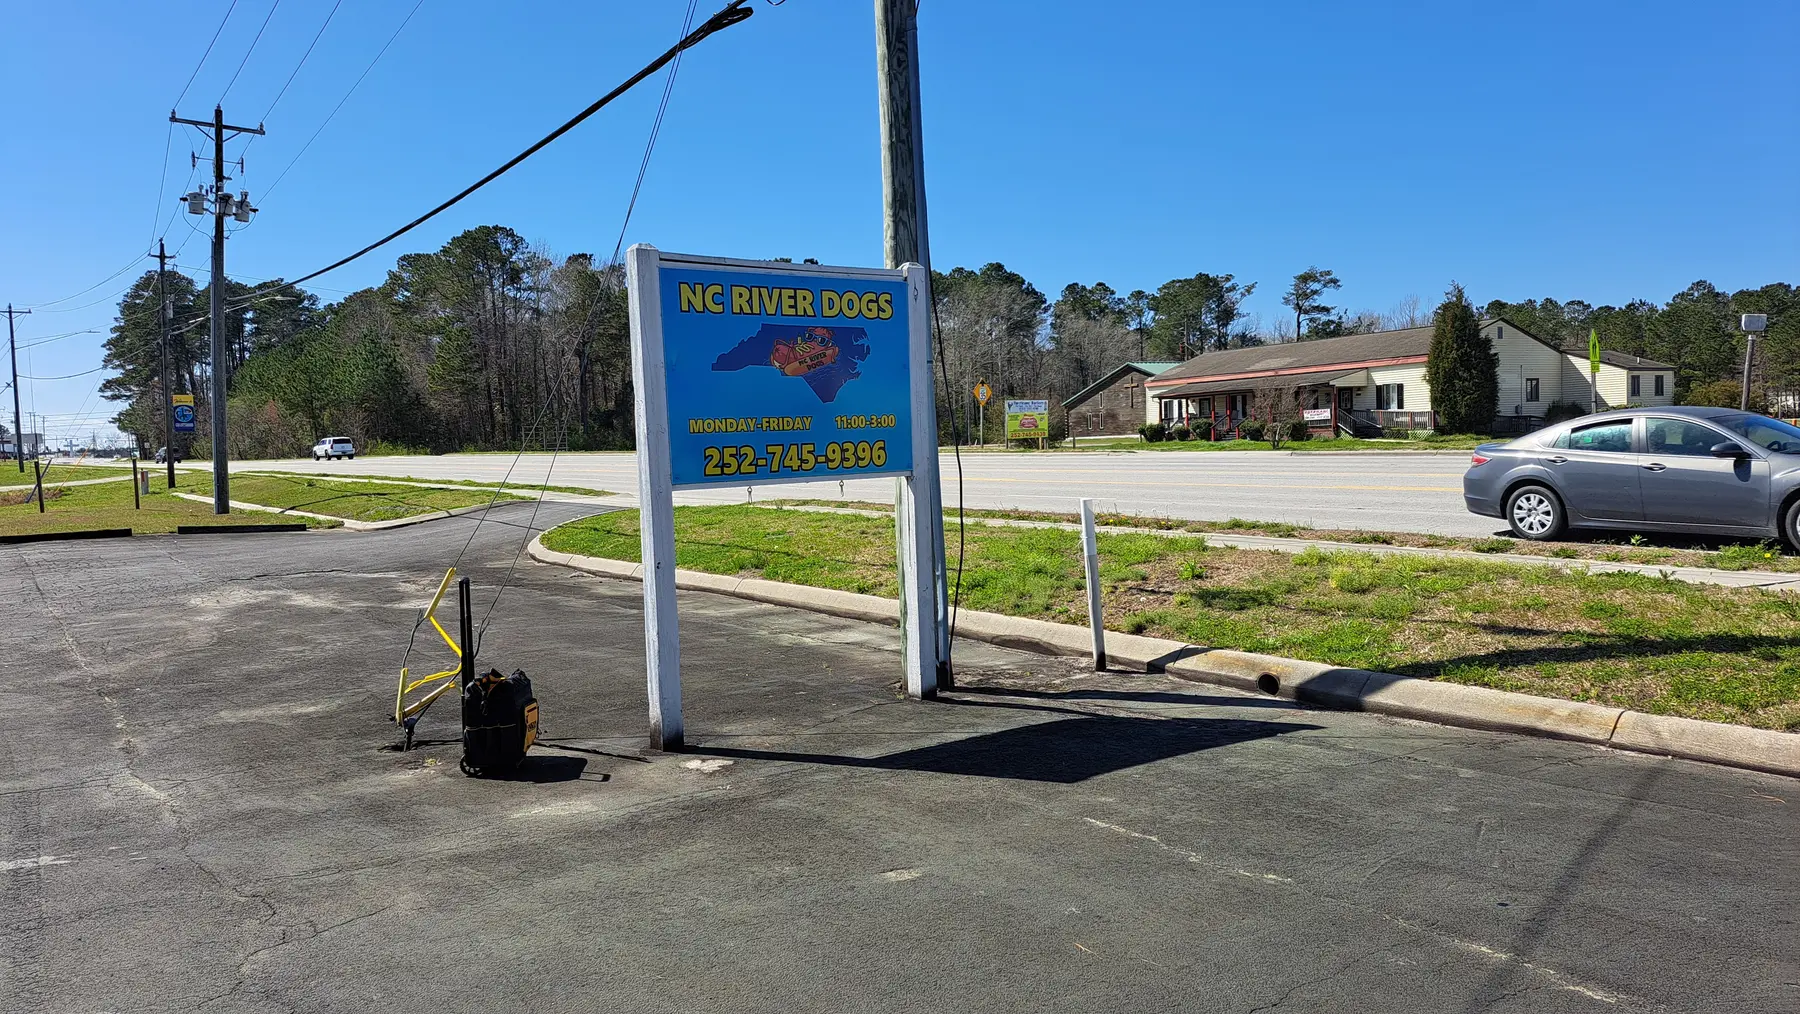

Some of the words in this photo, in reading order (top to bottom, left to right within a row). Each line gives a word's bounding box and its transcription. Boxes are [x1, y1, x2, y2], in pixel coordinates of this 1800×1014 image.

[679, 282, 723, 313] NC
[730, 284, 816, 317] RIVER
[820, 289, 893, 320] DOGS
[806, 361, 824, 371] DOGS
[810, 352, 828, 361] RIVER
[689, 416, 812, 434] MONDAY-FRIDAY
[834, 414, 896, 429] 11:00-3:00
[704, 440, 887, 476] 252-745-9396
